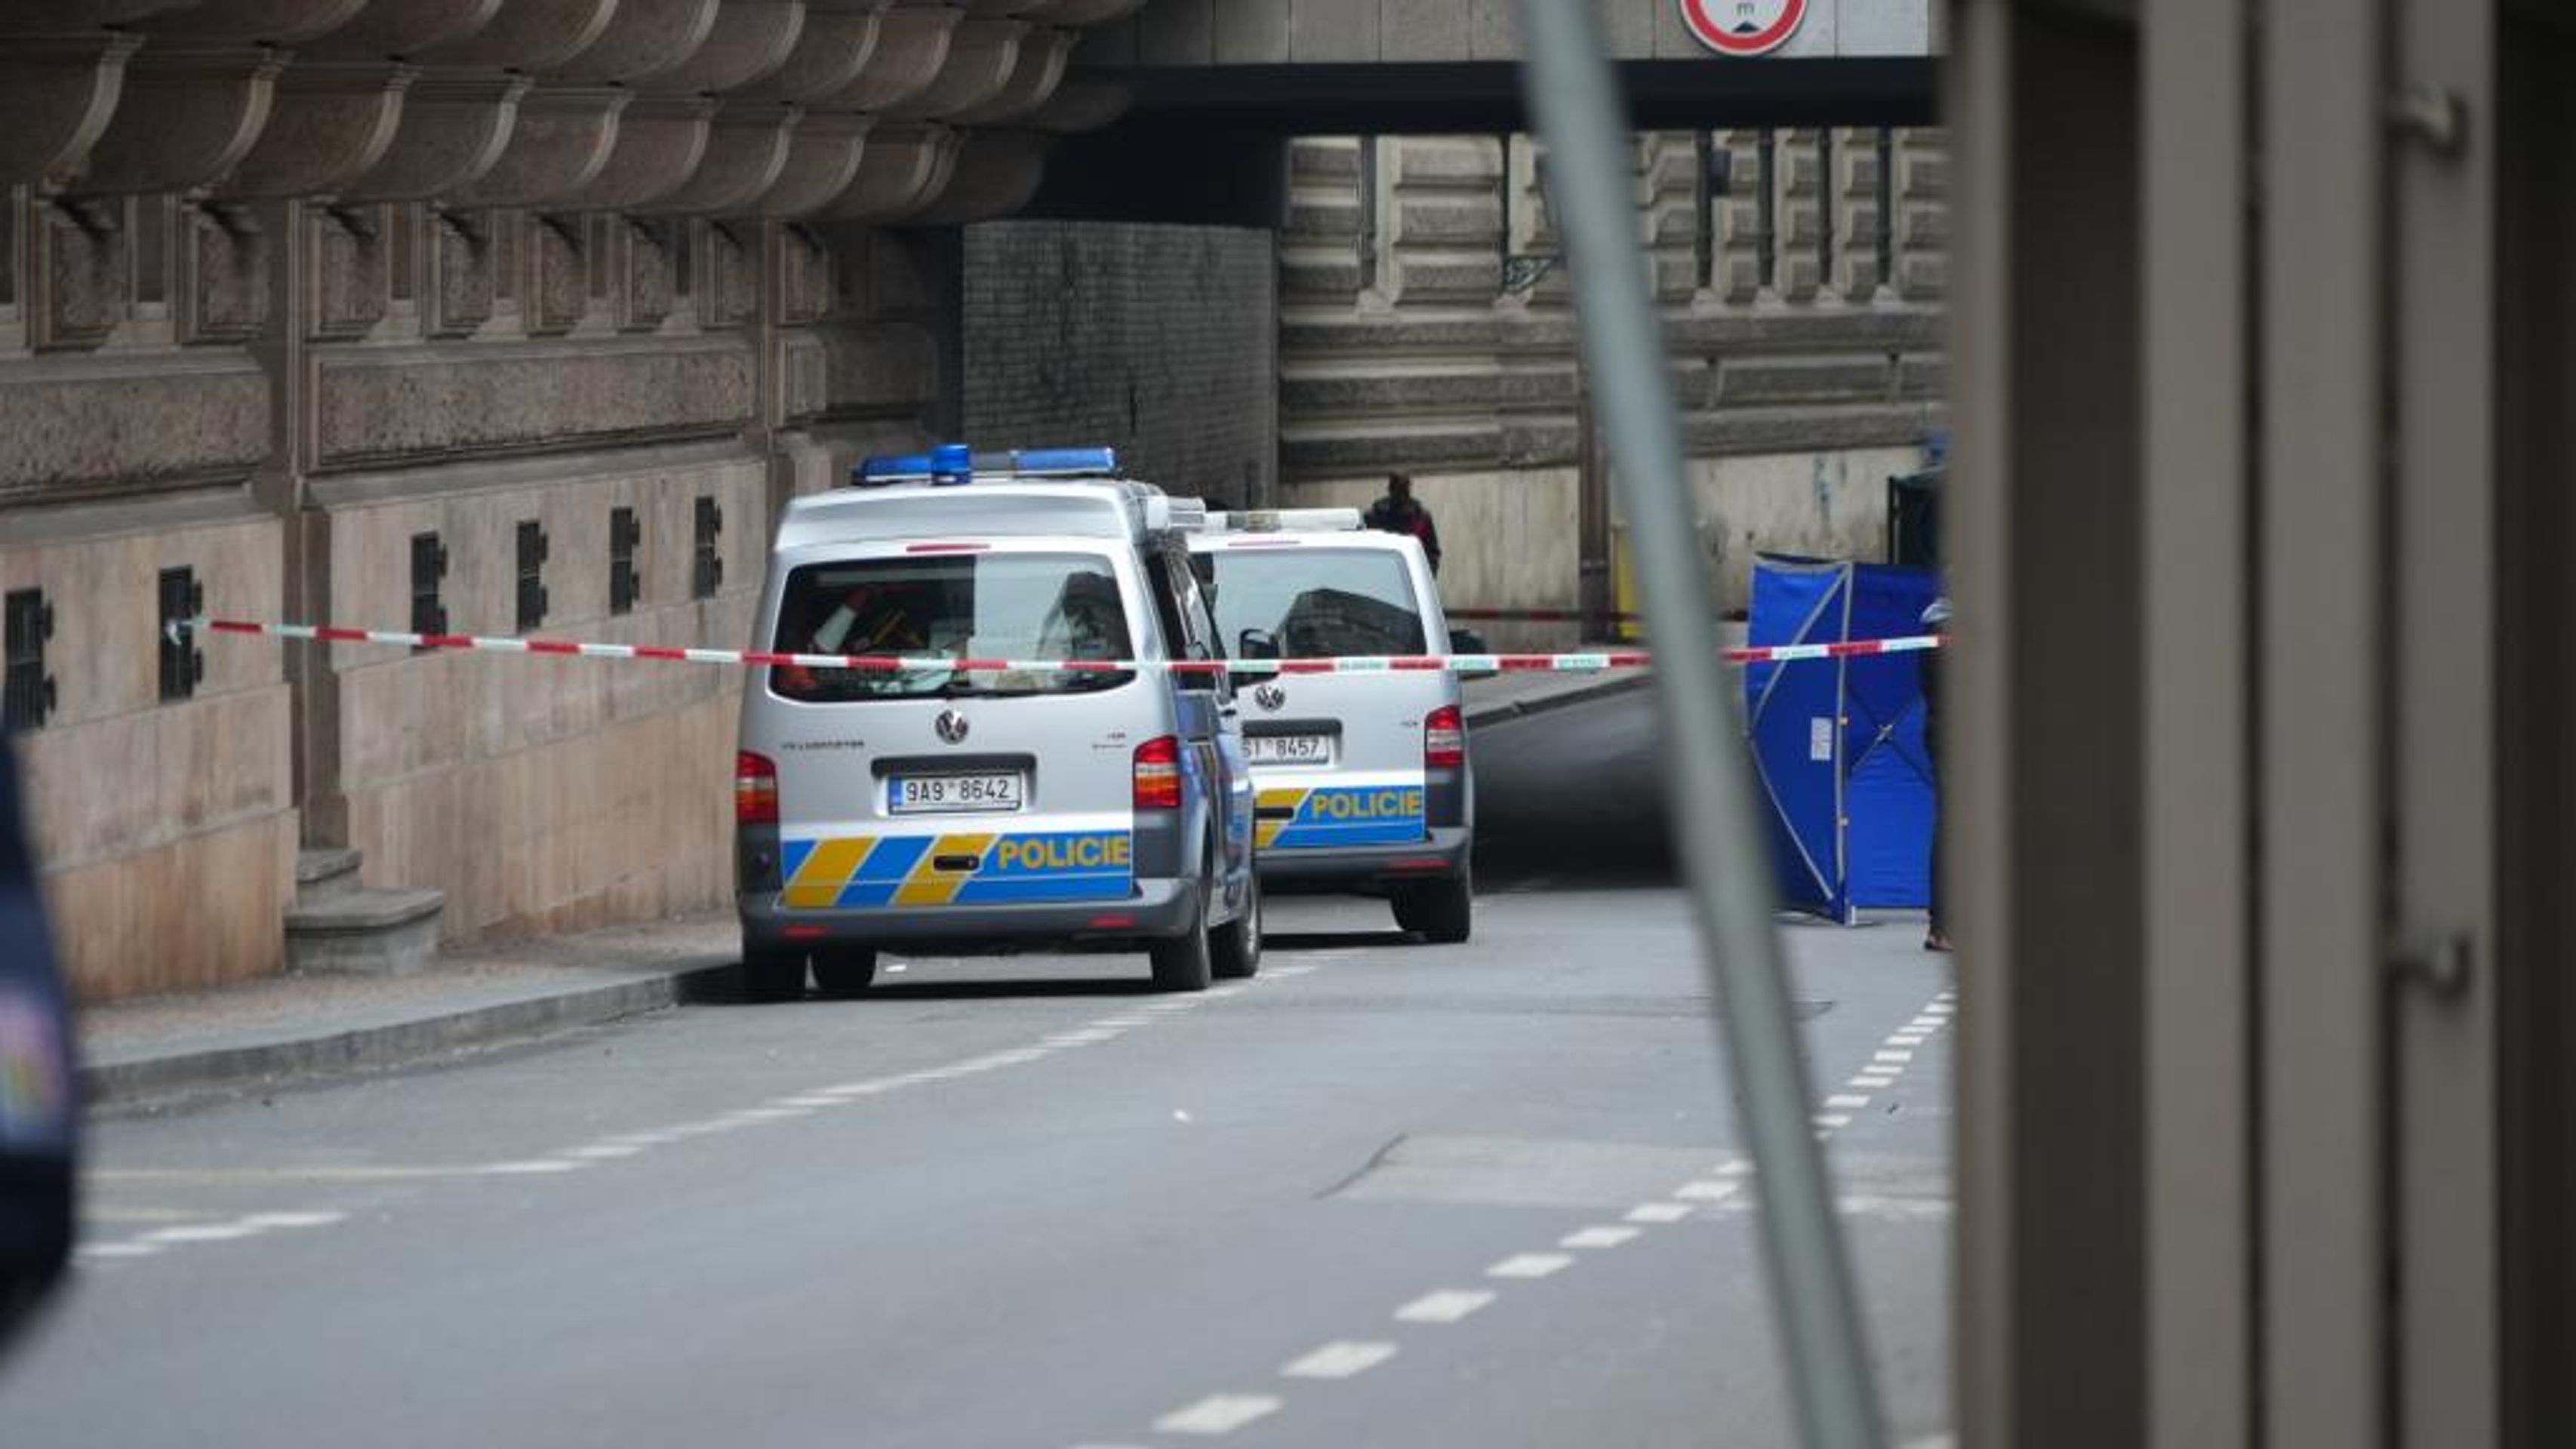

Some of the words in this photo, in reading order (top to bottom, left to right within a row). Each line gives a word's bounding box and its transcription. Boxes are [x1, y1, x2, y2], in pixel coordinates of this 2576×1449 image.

[1737, 2, 1754, 16] m
[906, 782, 944, 801] 9A9
[960, 779, 1010, 799] 8642
[1313, 791, 1421, 818] POLICIE
[999, 835, 1131, 869] POLICIE
